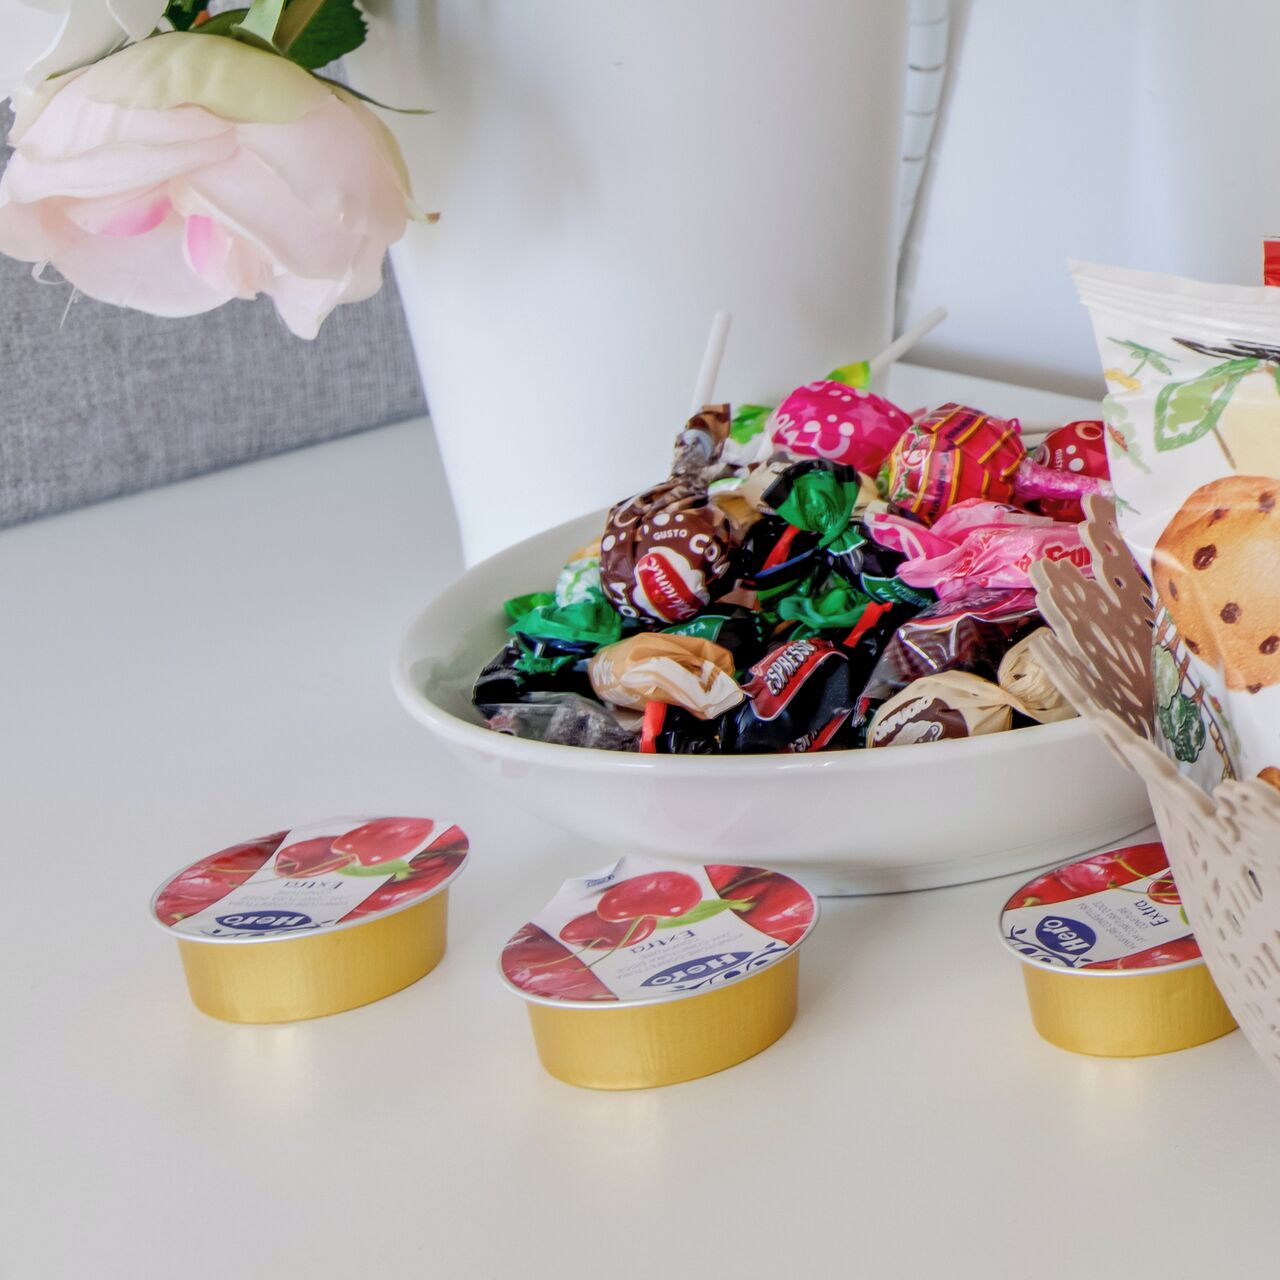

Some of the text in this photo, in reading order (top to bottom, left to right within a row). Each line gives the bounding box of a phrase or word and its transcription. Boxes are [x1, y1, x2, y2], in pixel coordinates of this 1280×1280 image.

[652, 528, 688, 541] GUSTO
[282, 880, 344, 890] Extra
[222, 915, 305, 928] Hero
[1134, 899, 1170, 928] Extra
[628, 929, 696, 955] Extra
[1043, 919, 1091, 953] Hero
[651, 953, 738, 986] Hero
